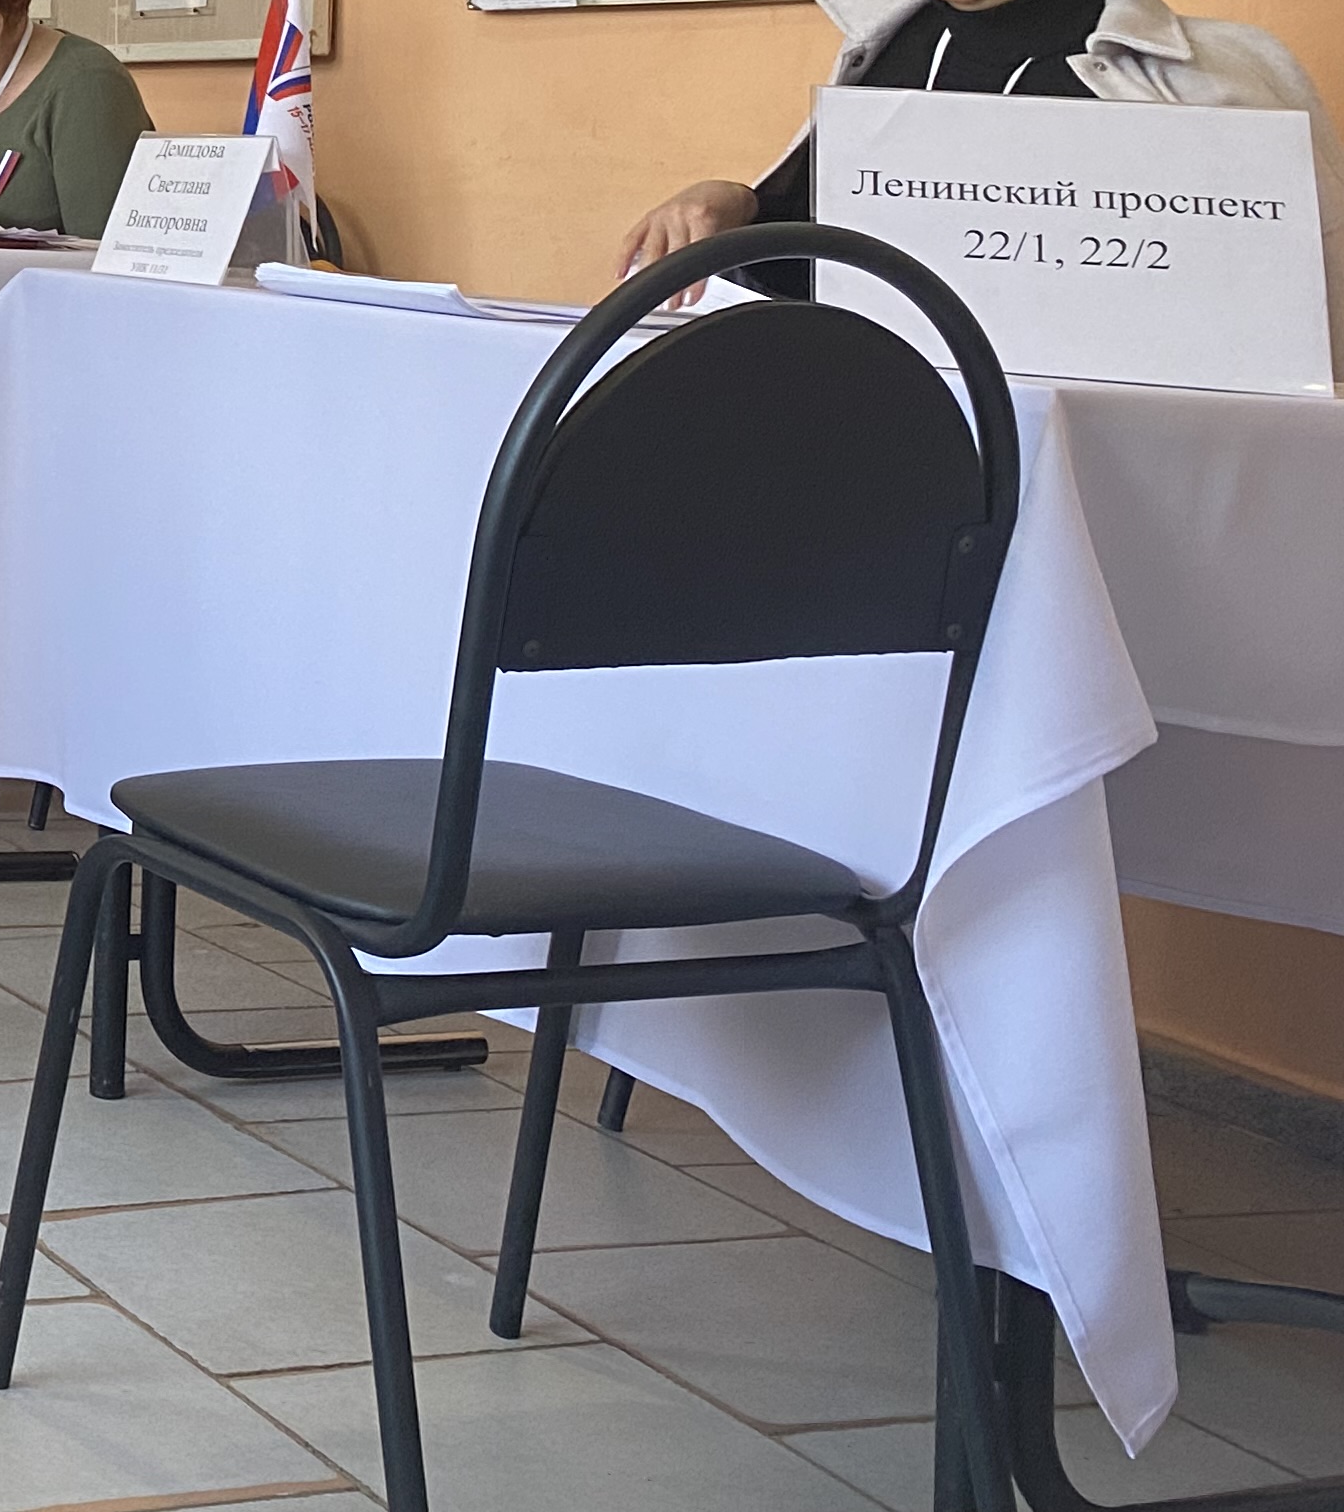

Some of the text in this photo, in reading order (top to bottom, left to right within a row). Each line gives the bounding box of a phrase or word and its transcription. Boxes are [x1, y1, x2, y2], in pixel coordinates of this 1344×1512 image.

[155, 140, 226, 160] Демидова
[148, 174, 212, 195] Светлана
[851, 168, 1287, 222] Ленинский проспект
[126, 210, 208, 235] Викторовна
[963, 229, 1172, 273] 22/1, 22/2
